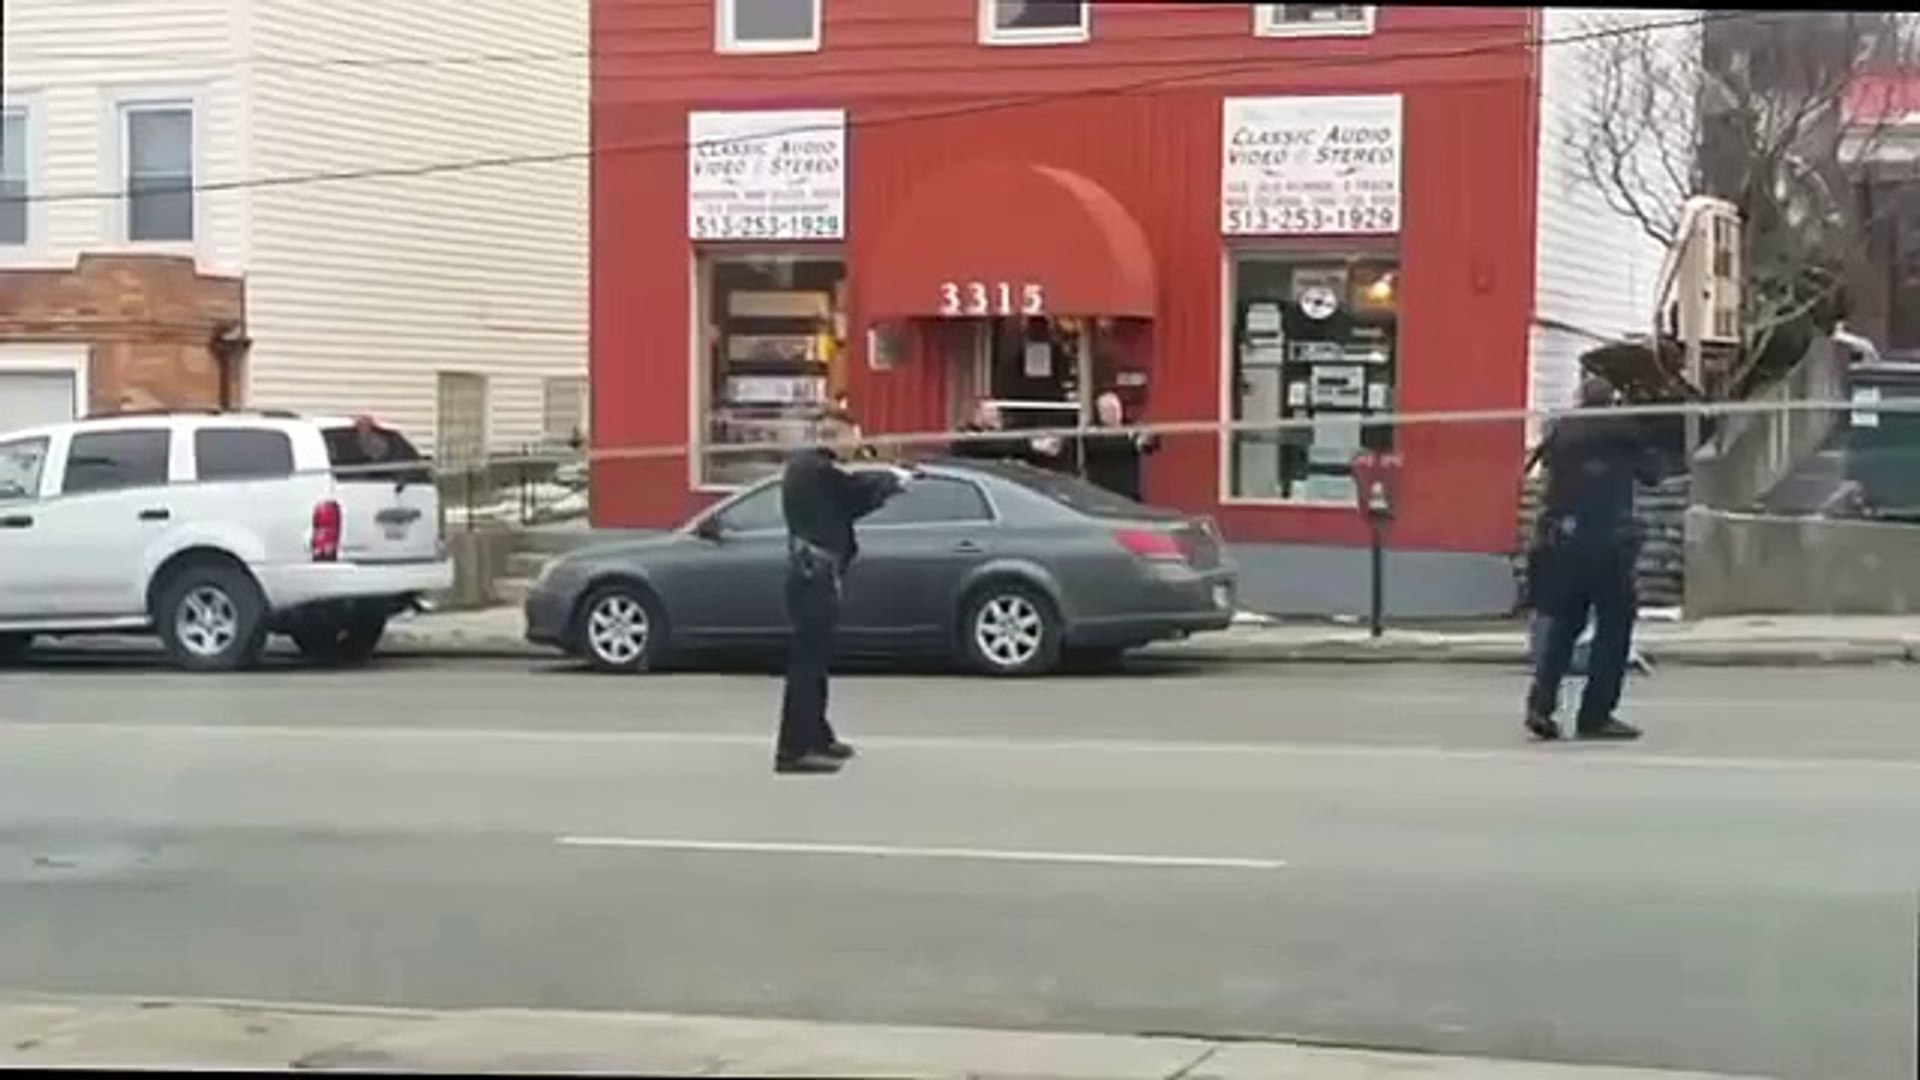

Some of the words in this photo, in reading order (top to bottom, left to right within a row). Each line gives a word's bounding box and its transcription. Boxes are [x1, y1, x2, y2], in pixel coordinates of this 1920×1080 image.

[1231, 125, 1317, 146] CLASSIC
[1324, 124, 1392, 145] AUDIO
[778, 140, 838, 155] AUDIO
[1229, 148, 1288, 166] VIDEO
[1314, 146, 1394, 165] STEREO
[769, 156, 840, 175] STEREO
[695, 214, 839, 236] 513-253-1929
[1227, 207, 1394, 231] 513-253-1929
[940, 281, 1043, 316] 3315
